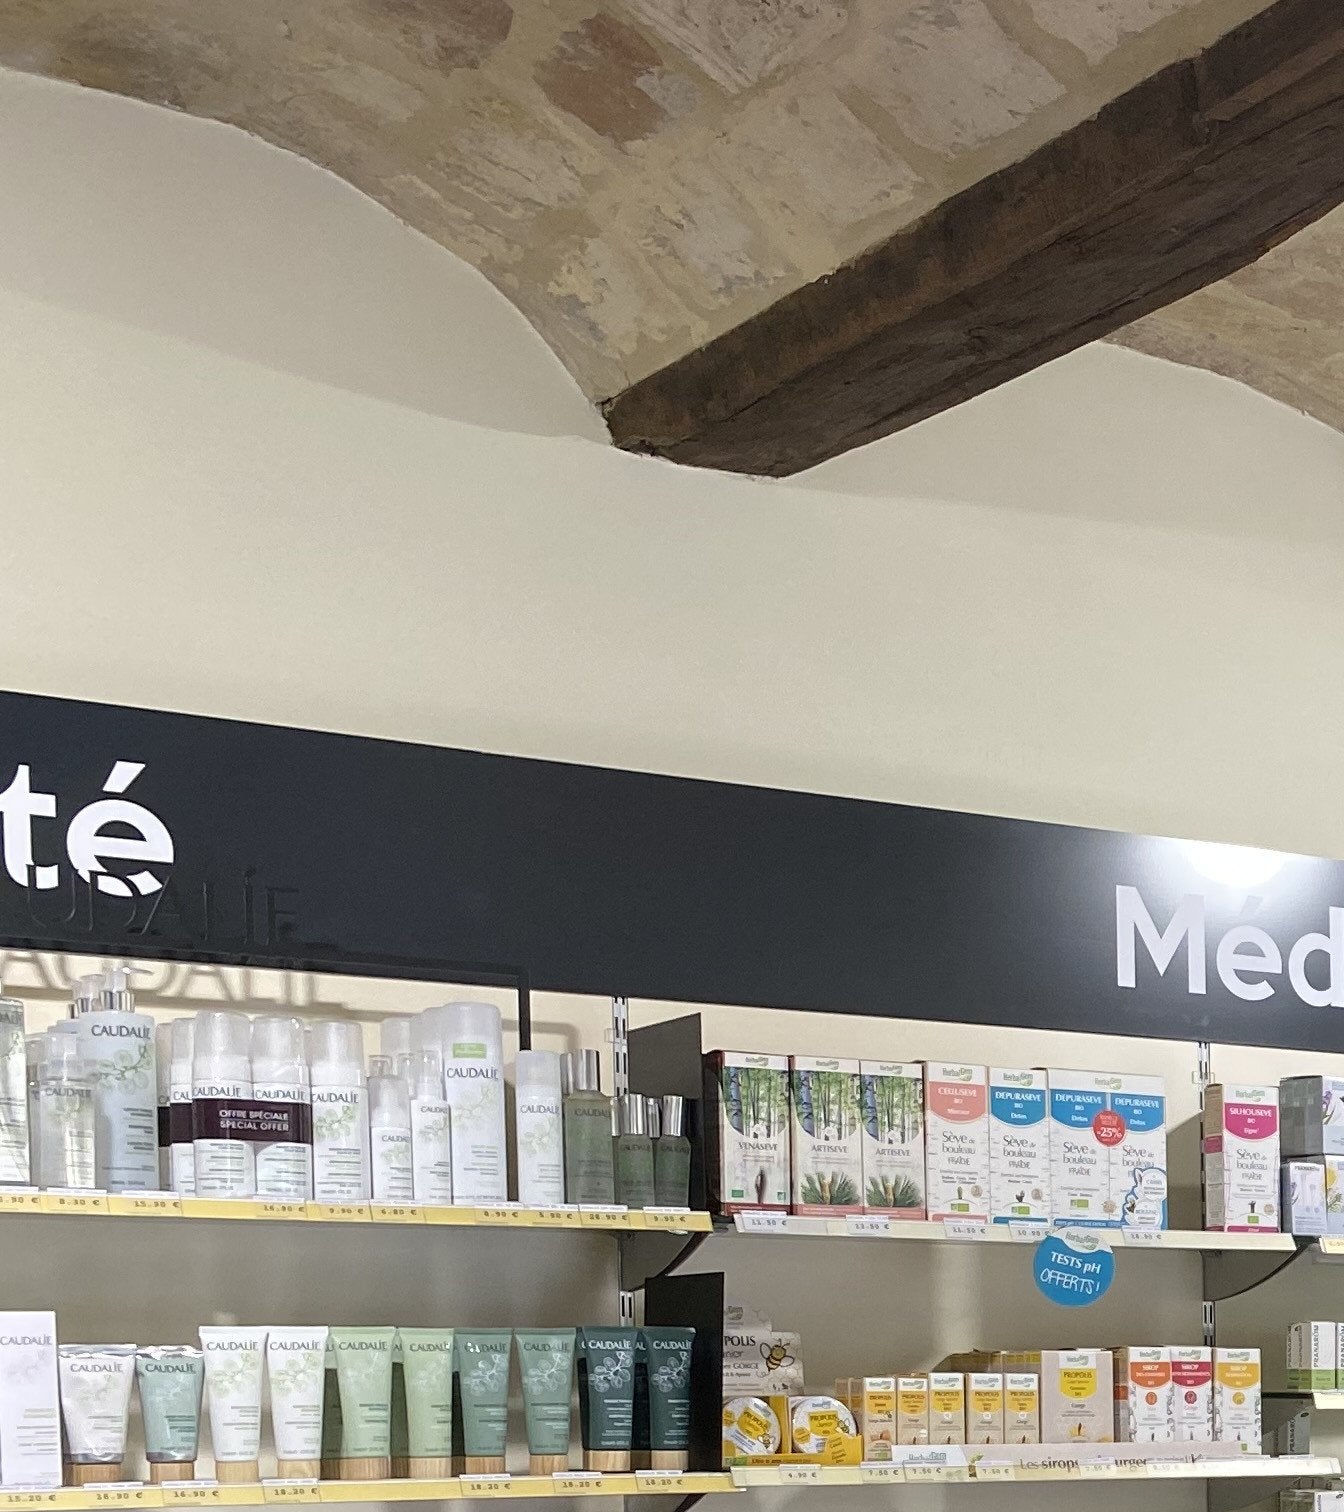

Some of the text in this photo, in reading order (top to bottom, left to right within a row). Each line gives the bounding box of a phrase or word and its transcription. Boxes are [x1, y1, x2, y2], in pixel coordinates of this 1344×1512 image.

[219, 1110, 246, 1119] OFFRE
[220, 1120, 288, 1132] SPECIAL OFFER
[1051, 1251, 1101, 1274] TESTS pH
